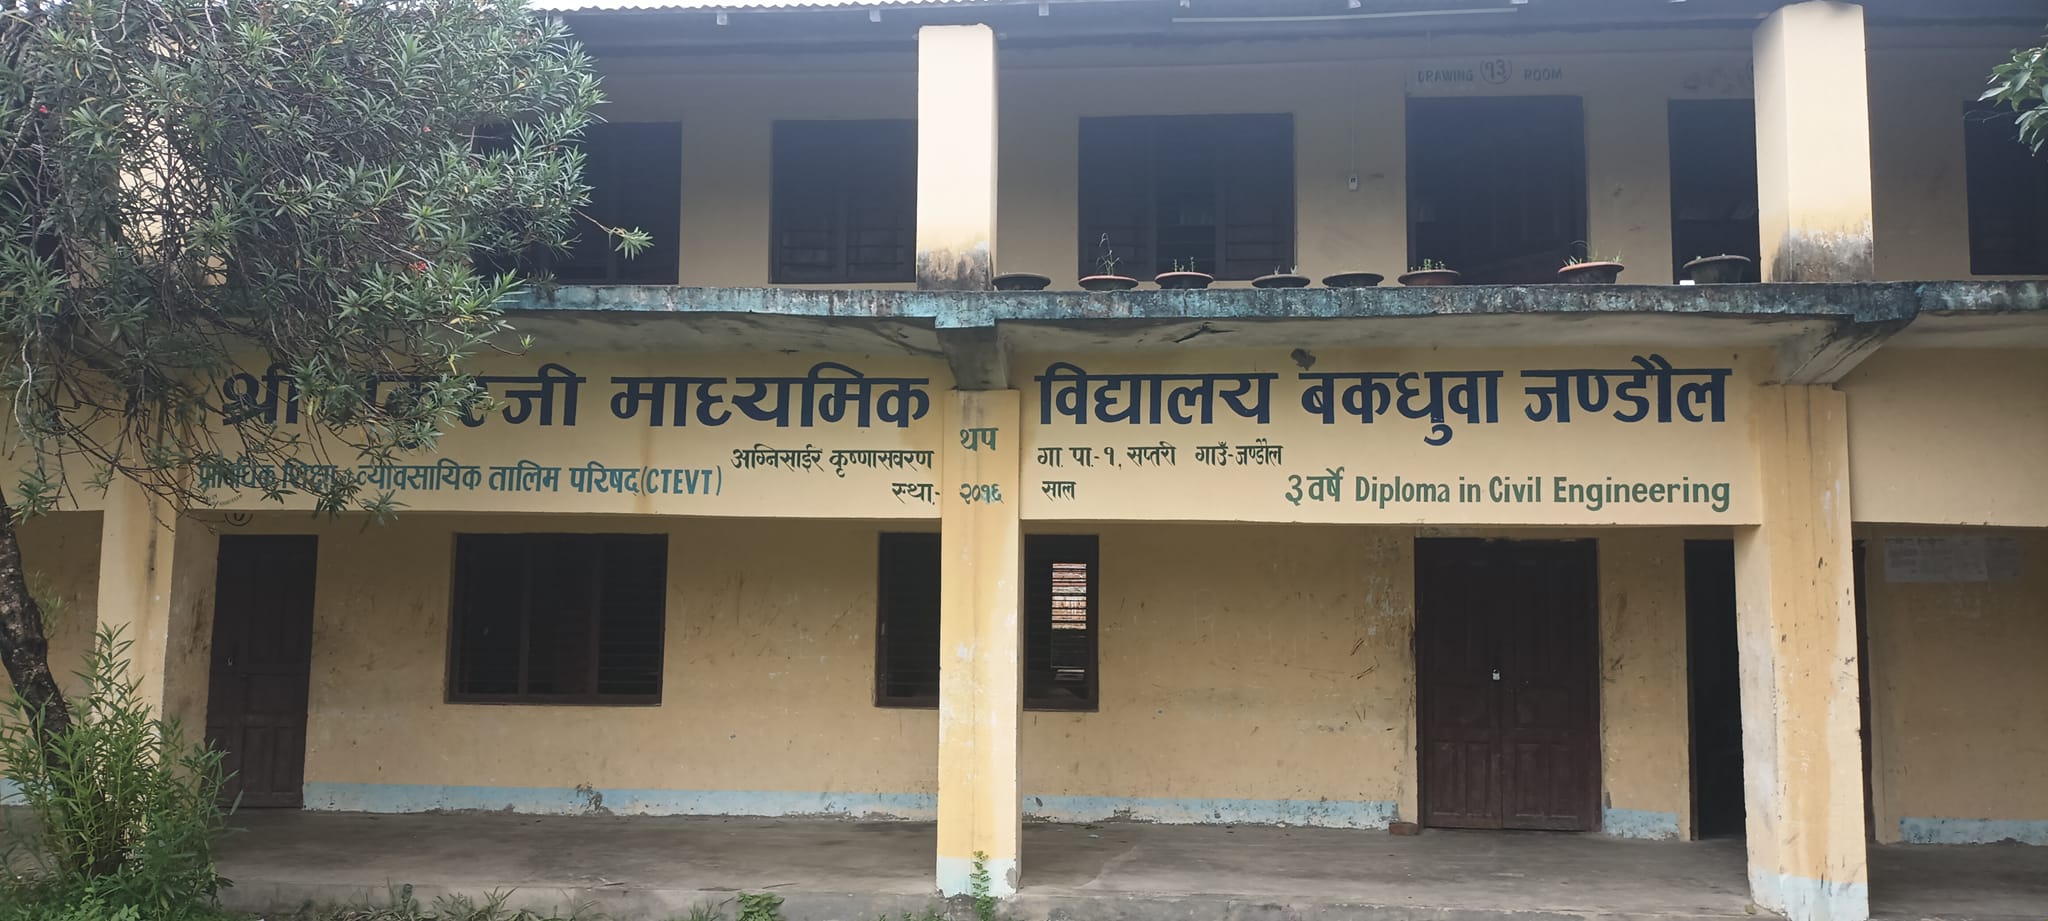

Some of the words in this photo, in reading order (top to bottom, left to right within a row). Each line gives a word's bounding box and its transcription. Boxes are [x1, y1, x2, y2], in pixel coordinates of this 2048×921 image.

[1523, 67, 1563, 81] ROOM
[223, 363, 300, 426] श्री
[610, 362, 930, 428] माध्यमिक
[1034, 361, 1279, 425] विद्यालय
[1298, 371, 1504, 446] बकधुवा
[1520, 354, 1733, 424] जण्डौल
[959, 427, 999, 452] थप
[1126, 440, 1177, 467] सप्तरी
[488, 459, 562, 492] तालिम
[829, 449, 935, 478] कृष्णासवरण
[959, 483, 1004, 504] २०१६
[1042, 480, 1077, 501] साल
[1355, 475, 1450, 509] Diploma
[1459, 476, 1481, 503] in
[1489, 477, 1541, 504] Civil
[1554, 477, 1731, 513] Engineering
